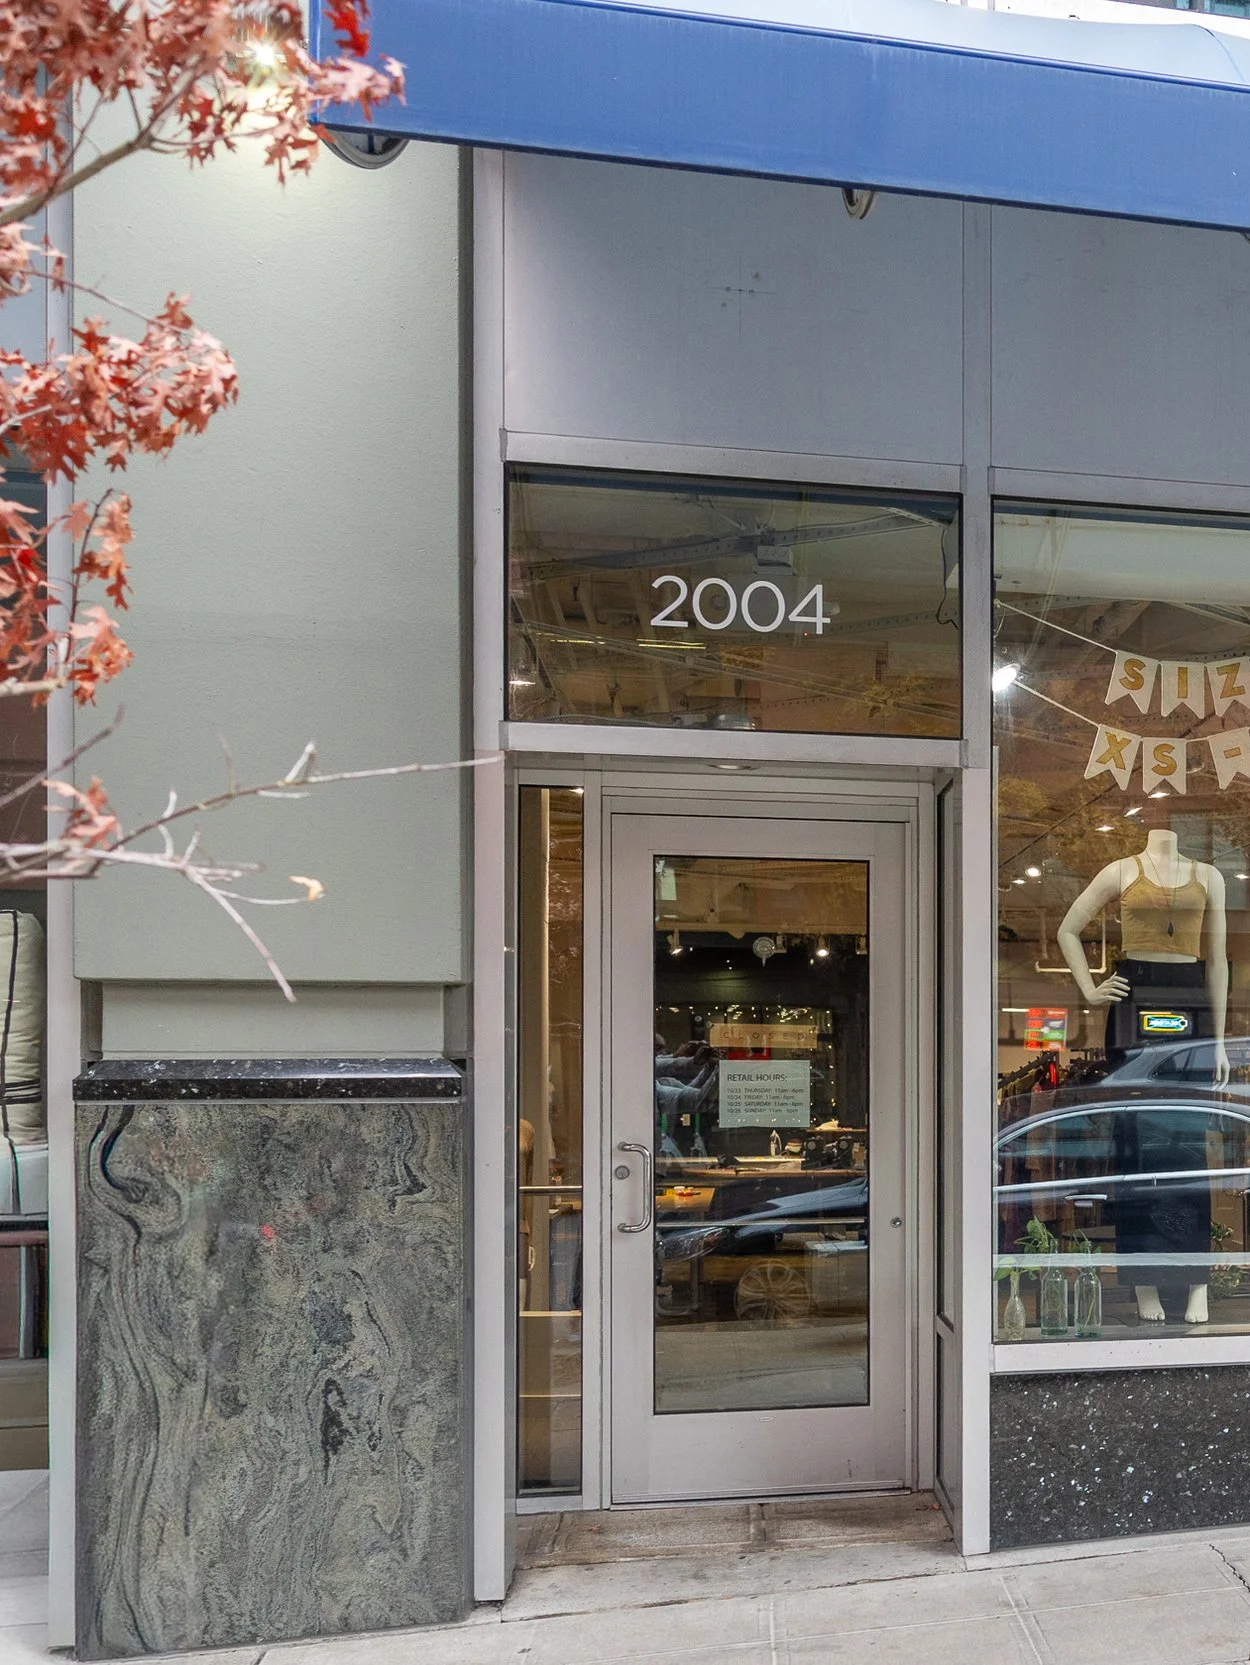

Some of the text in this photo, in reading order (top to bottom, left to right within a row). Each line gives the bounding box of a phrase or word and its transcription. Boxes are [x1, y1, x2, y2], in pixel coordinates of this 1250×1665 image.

[650, 575, 831, 635] 2004
[1095, 732, 1177, 776] XS
[723, 1032, 805, 1040] CLOSED
[727, 1074, 788, 1082] RETAIL HOURS:
